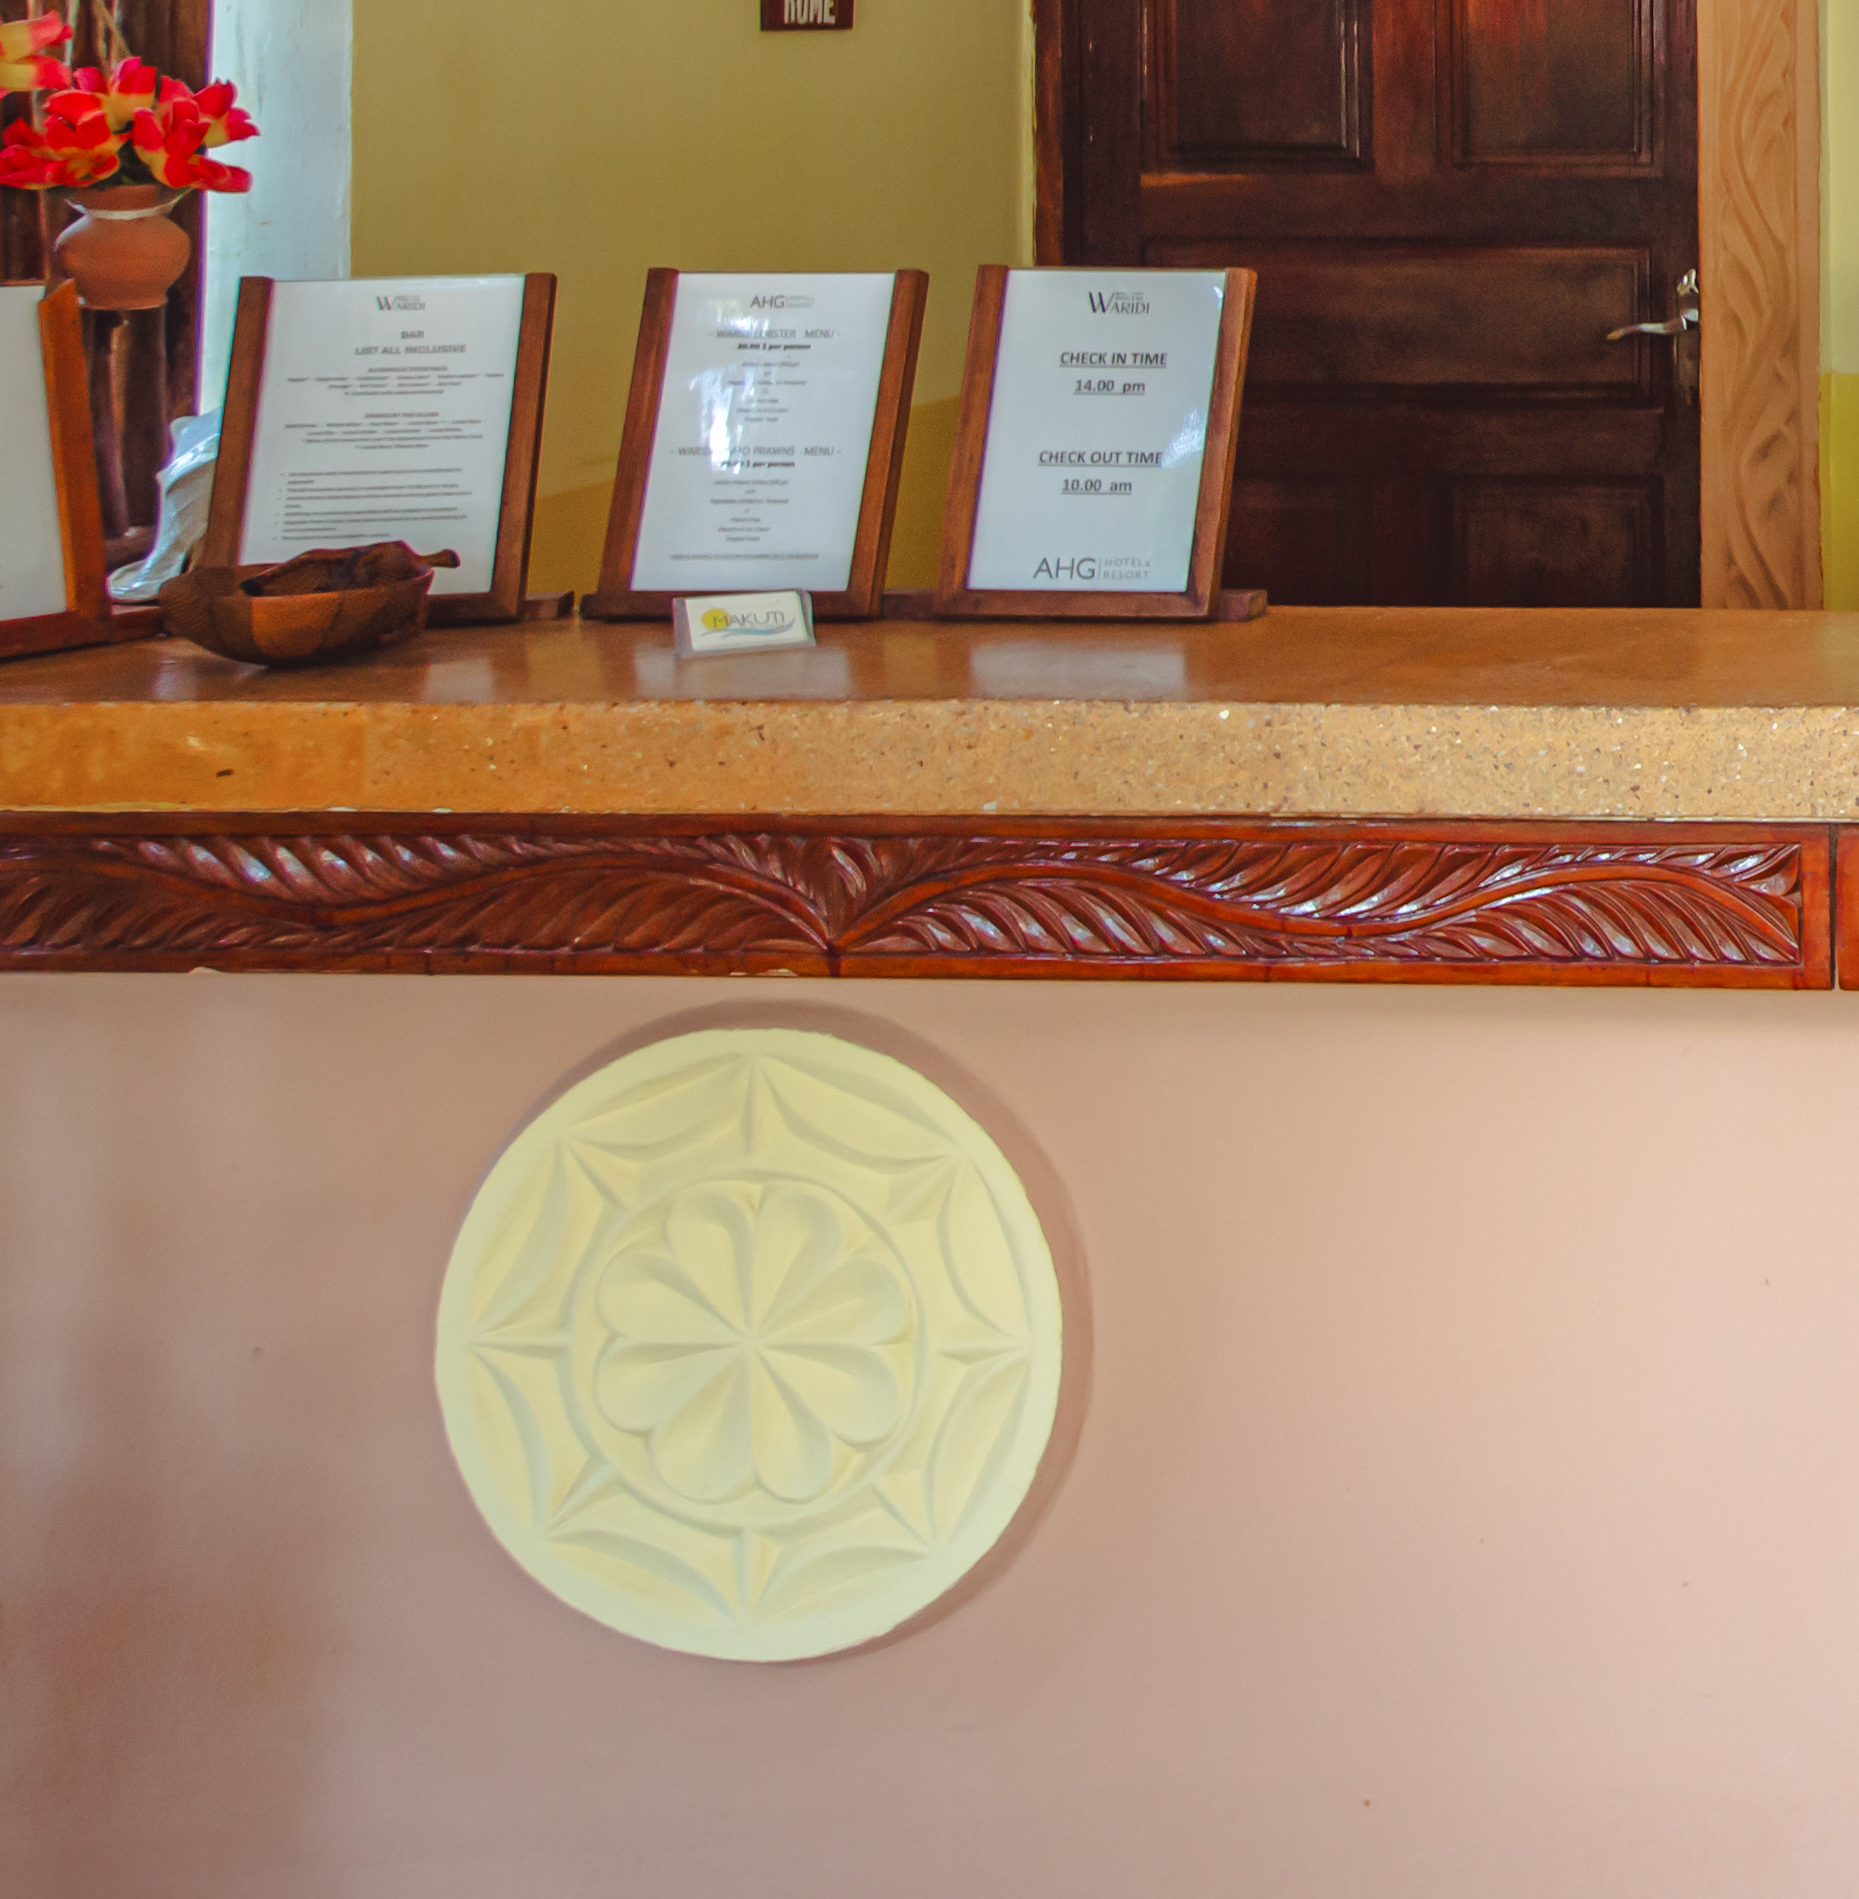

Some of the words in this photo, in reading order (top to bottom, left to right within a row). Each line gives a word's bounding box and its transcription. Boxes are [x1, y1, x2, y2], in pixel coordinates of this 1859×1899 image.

[750, 295, 785, 309] AHG
[1088, 291, 1150, 315] WARIDI
[381, 345, 402, 354] ALL
[1060, 352, 1106, 366] CHECK
[1112, 352, 1128, 365] IN
[1131, 352, 1167, 366] TIME
[1075, 379, 1114, 393] 14.00
[1121, 382, 1146, 394] pm
[1038, 451, 1086, 464] CHECK
[1090, 451, 1122, 464] OUT
[1127, 451, 1163, 464] TIME
[1062, 478, 1102, 493] 10.00
[1110, 481, 1133, 492] am
[1032, 557, 1096, 581] AHG
[711, 610, 786, 629] MAKUTI
